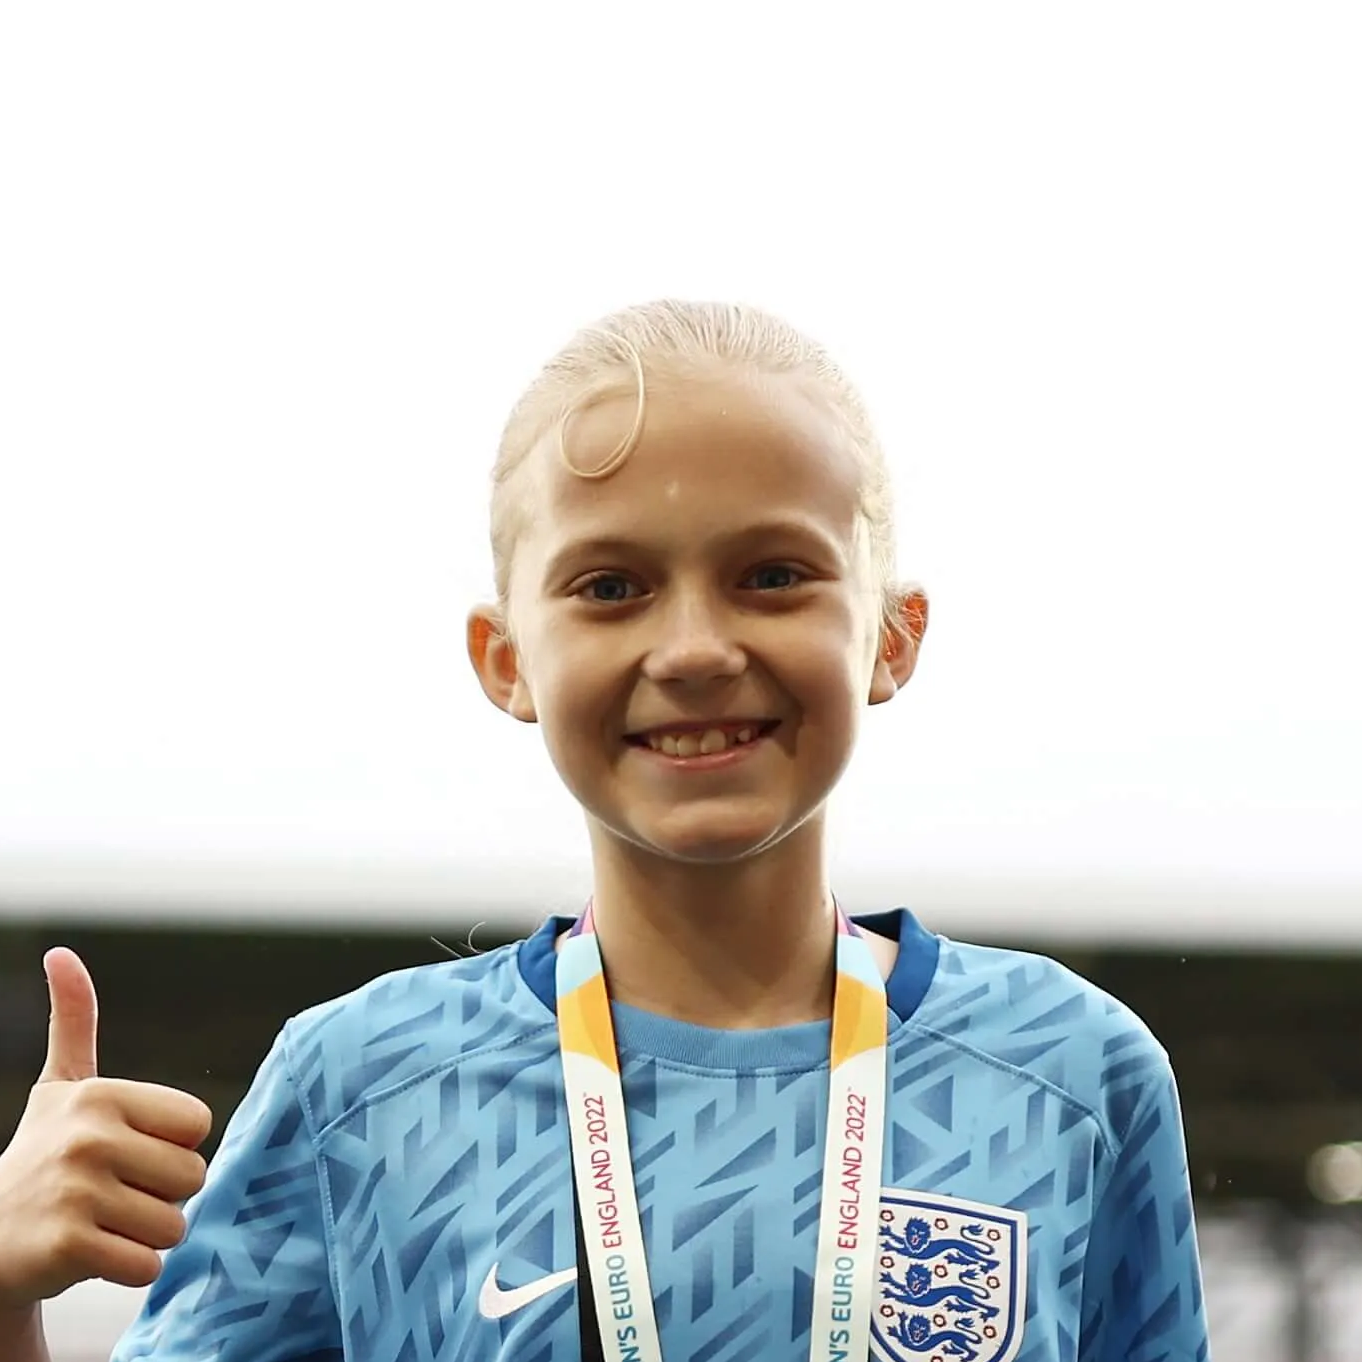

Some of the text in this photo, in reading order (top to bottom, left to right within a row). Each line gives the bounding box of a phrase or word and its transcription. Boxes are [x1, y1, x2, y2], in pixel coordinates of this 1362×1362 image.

[584, 1095, 608, 1145] 2022
[845, 1093, 867, 1142] 2022
[591, 1149, 623, 1249] ENGLAND
[837, 1146, 863, 1249] ENGLAND
[606, 1254, 633, 1321] EURO
[831, 1256, 855, 1323] EURO
